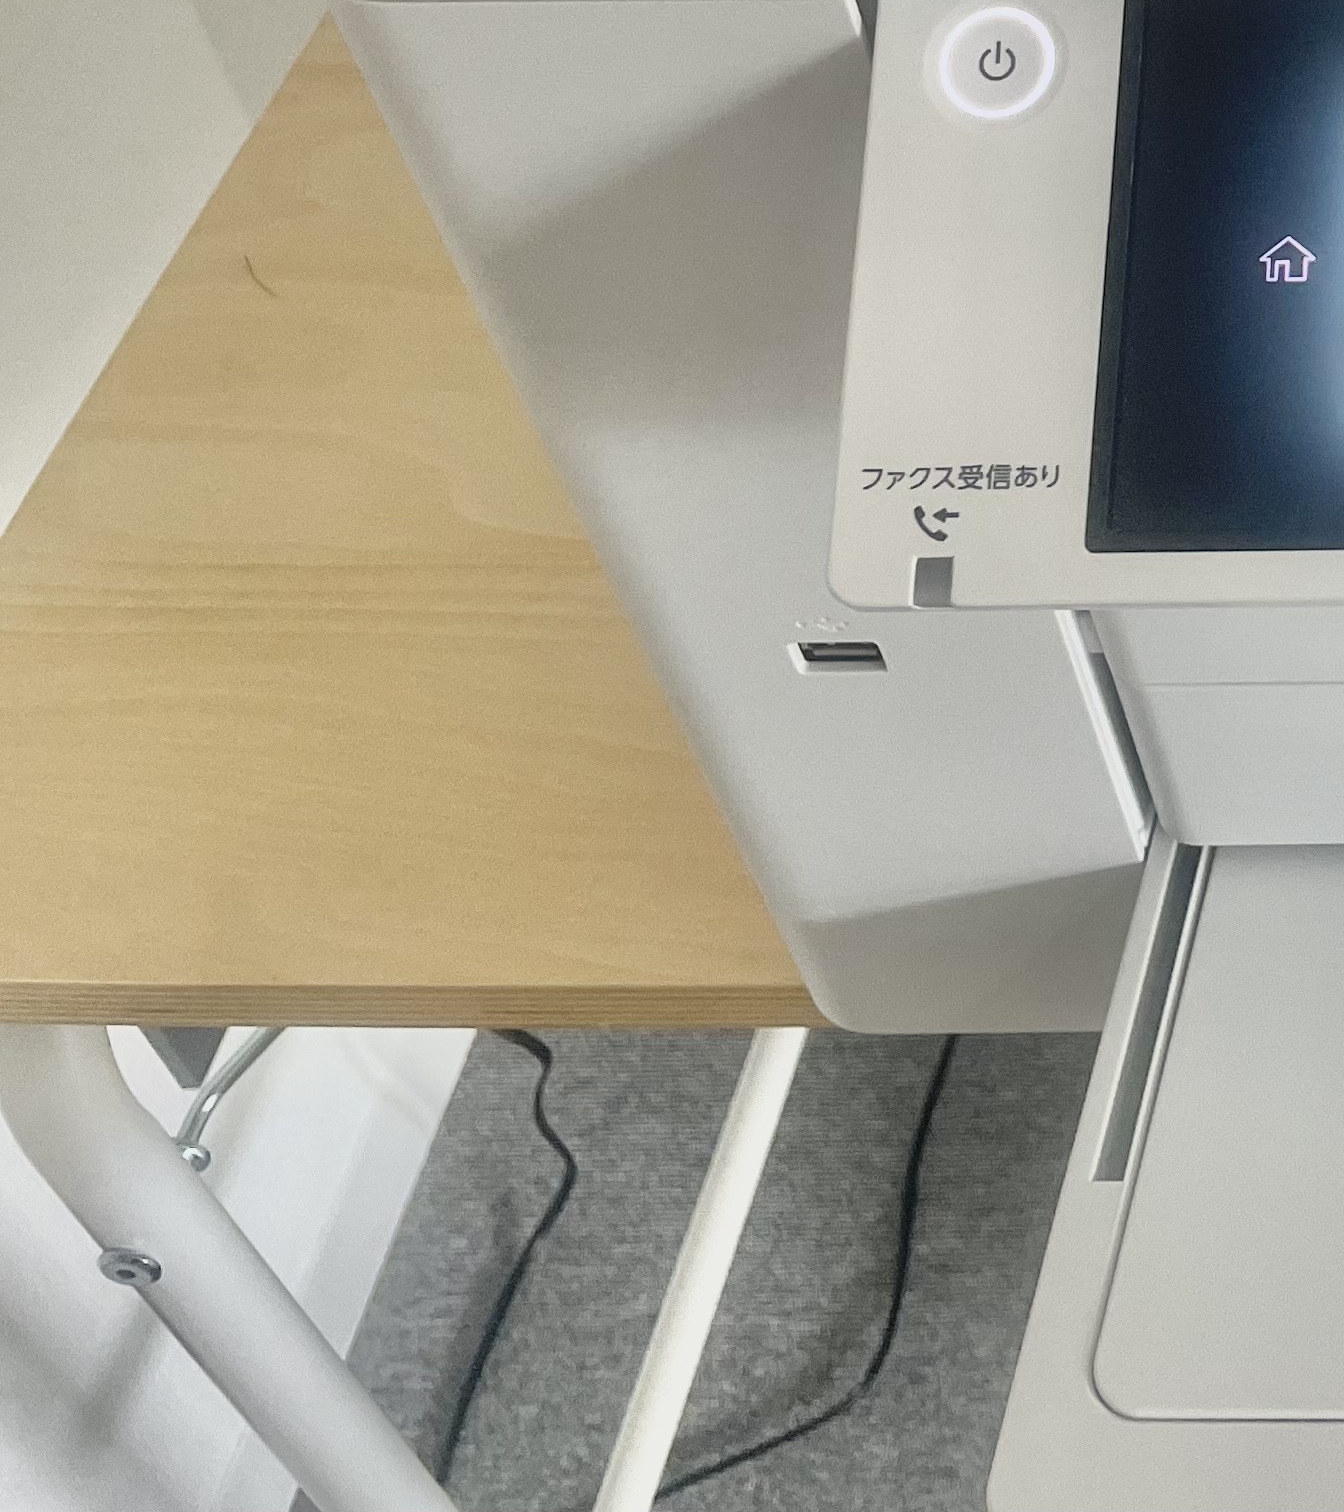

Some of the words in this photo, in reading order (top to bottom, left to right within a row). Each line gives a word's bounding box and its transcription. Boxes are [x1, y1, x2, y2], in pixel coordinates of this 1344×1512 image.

[861, 463, 1061, 490] ファクス受信あり
